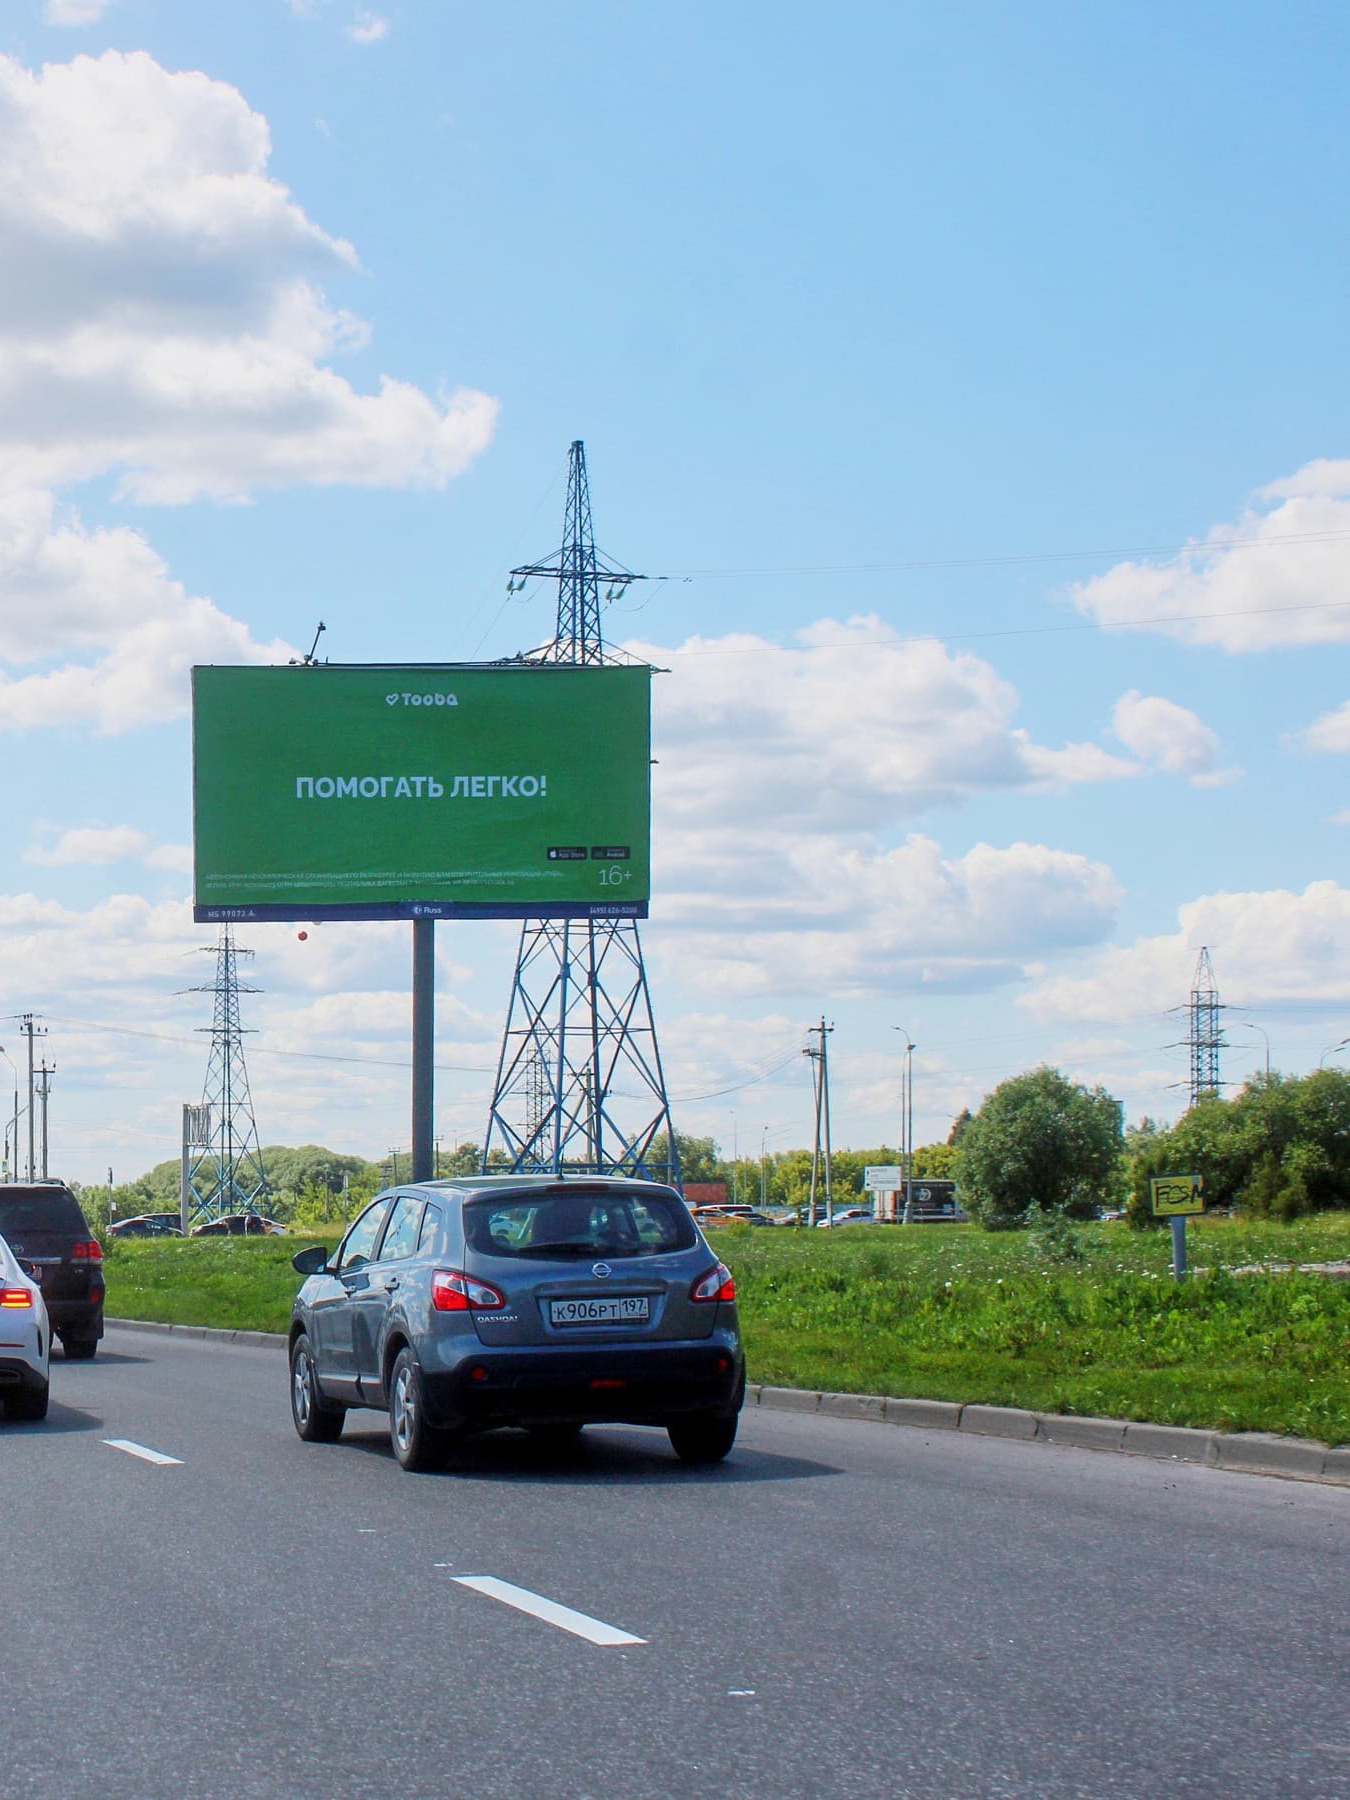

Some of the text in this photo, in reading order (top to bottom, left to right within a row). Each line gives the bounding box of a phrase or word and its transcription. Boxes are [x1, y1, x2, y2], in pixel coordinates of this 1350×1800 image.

[402, 692, 458, 706] Tooba
[296, 775, 547, 799] ПОМОГАТЬ ЛЕГКО!
[598, 864, 632, 886] 16+
[423, 906, 442, 914] Russ
